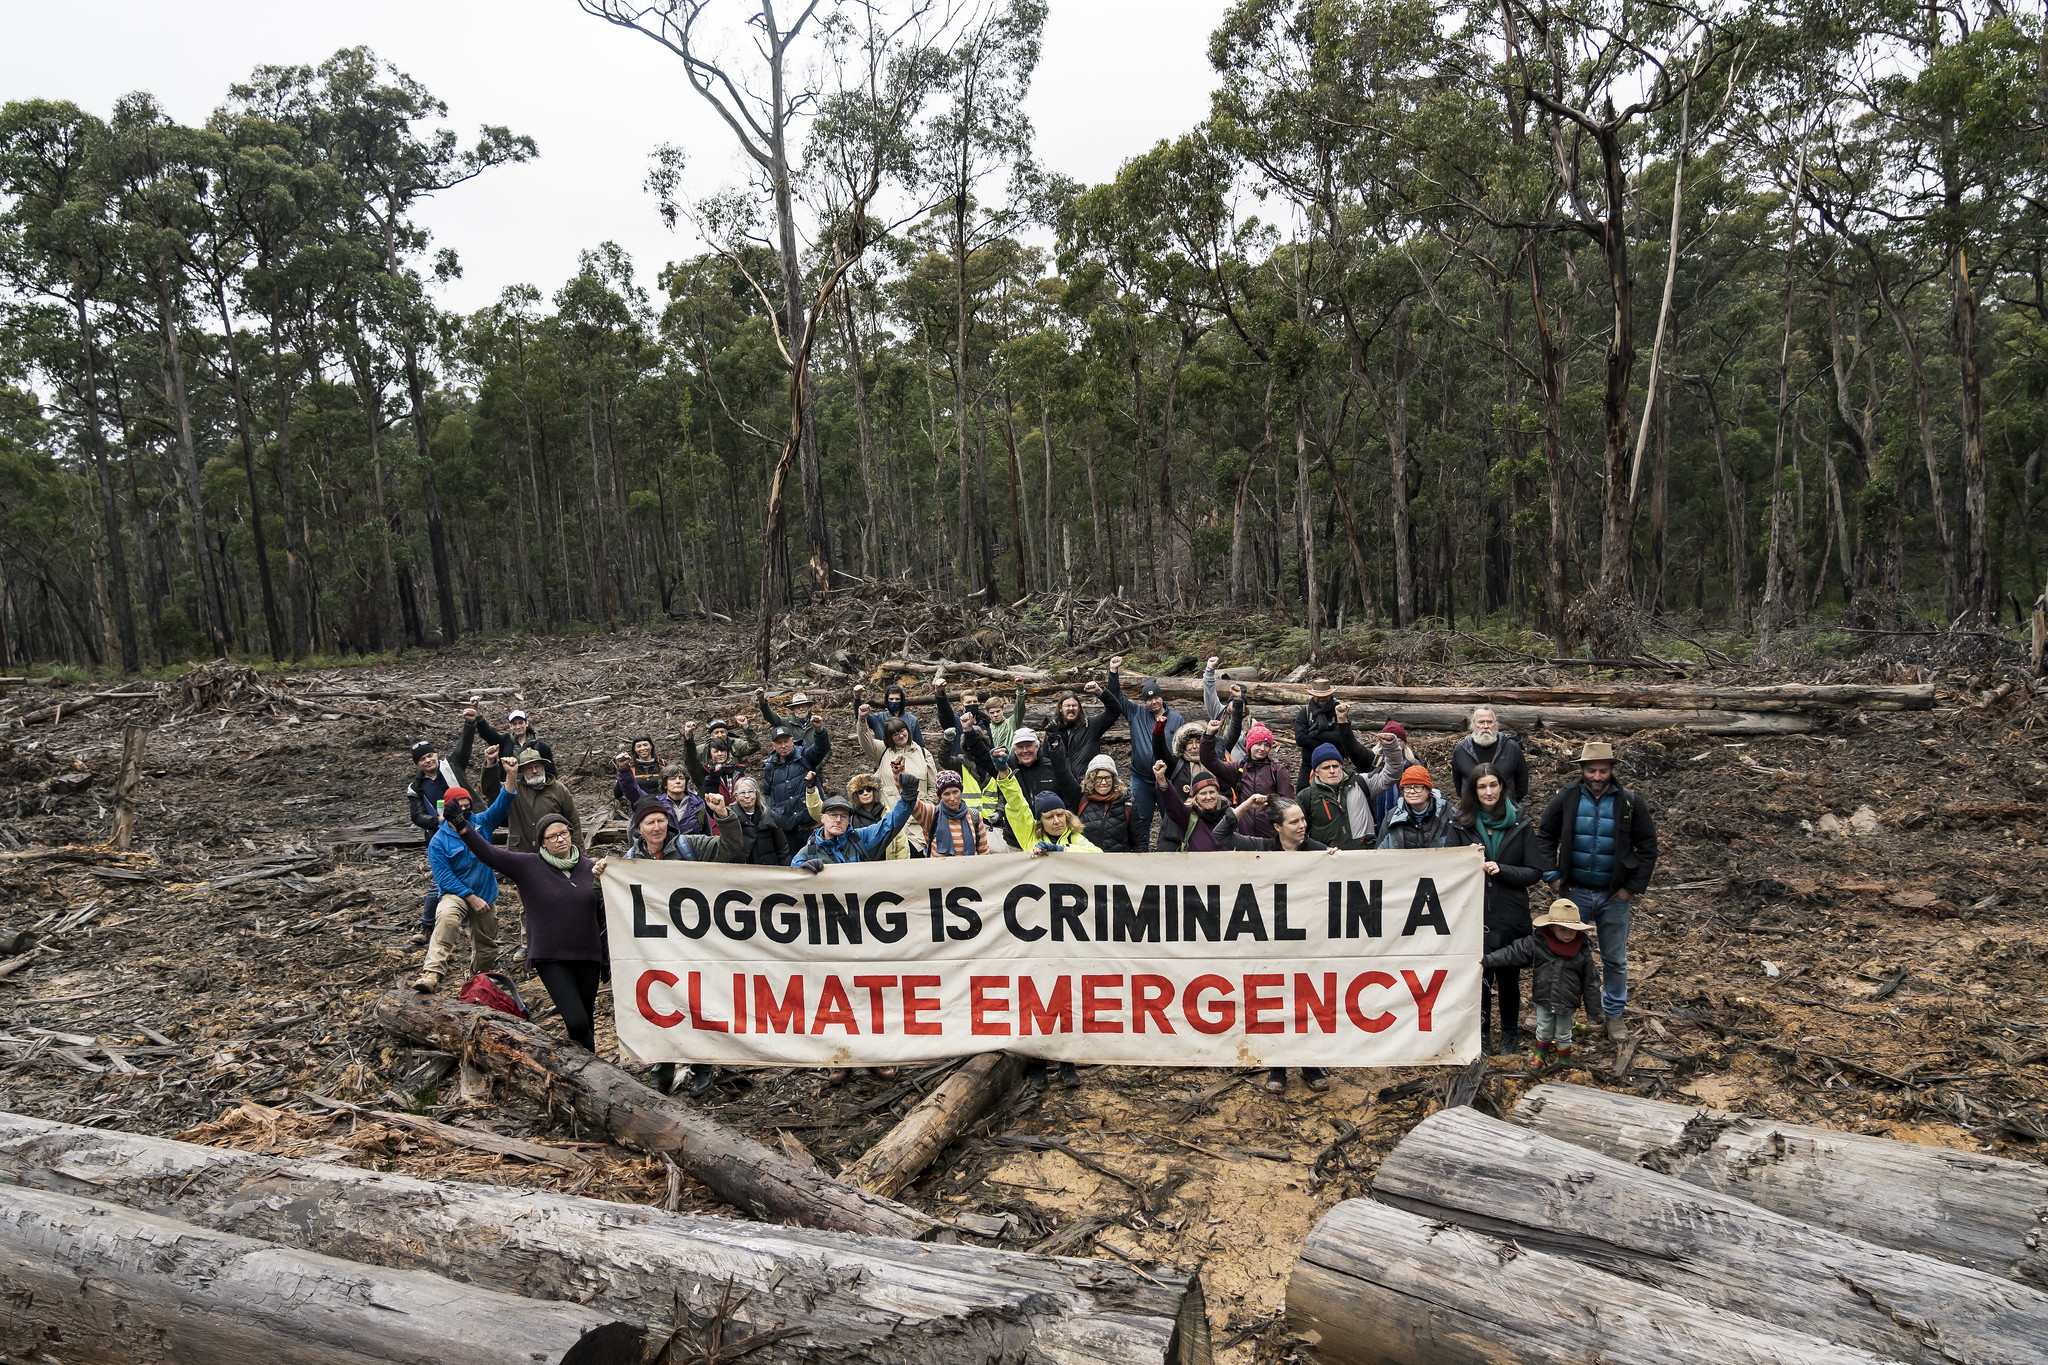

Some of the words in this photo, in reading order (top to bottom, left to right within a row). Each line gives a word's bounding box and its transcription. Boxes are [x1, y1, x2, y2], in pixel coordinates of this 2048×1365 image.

[630, 884, 908, 945] LOGGING
[928, 883, 983, 943] IS
[1004, 881, 1307, 943] CRIMINAL
[1327, 880, 1383, 939] IN
[1400, 878, 1451, 937] A
[635, 969, 944, 1036] CLIMATE
[969, 969, 1448, 1036] EMERGENCY
